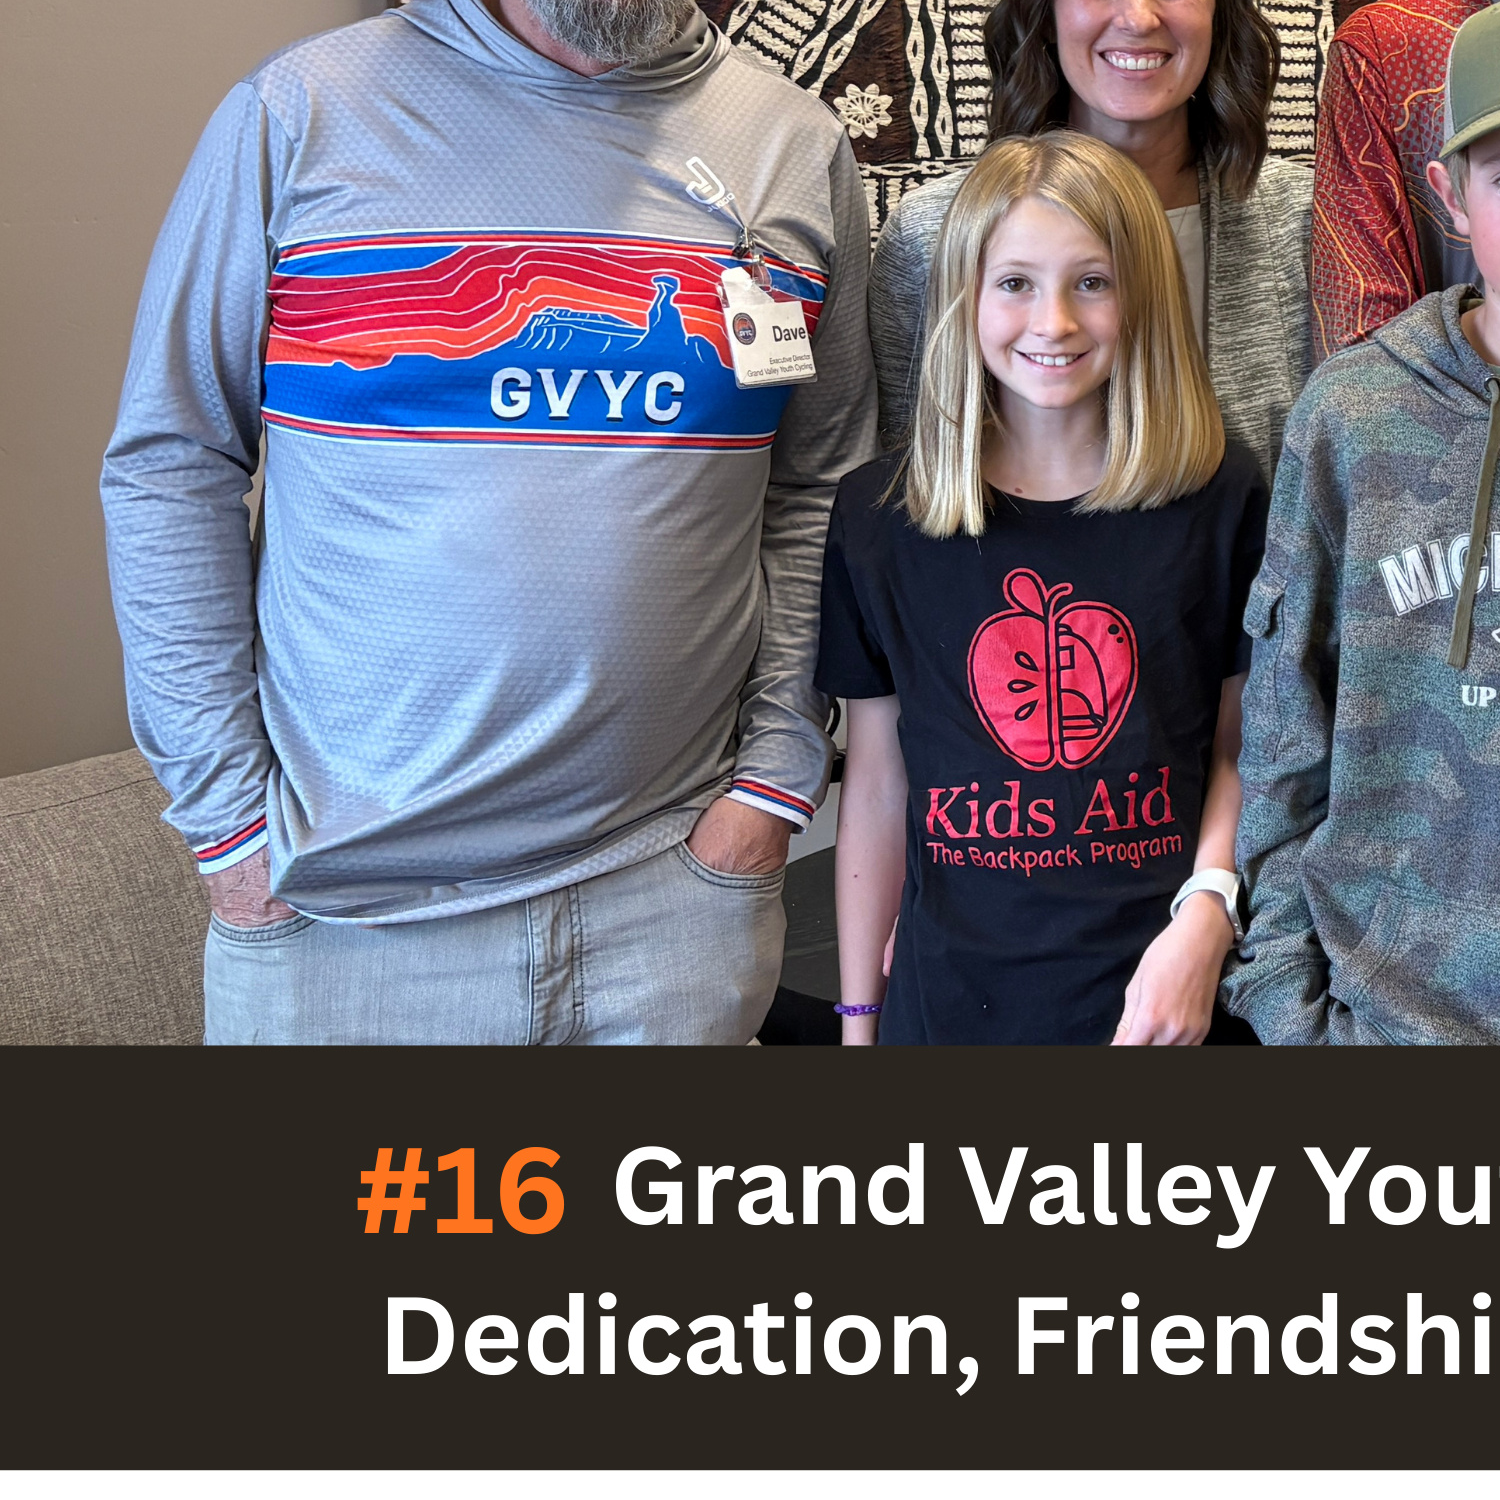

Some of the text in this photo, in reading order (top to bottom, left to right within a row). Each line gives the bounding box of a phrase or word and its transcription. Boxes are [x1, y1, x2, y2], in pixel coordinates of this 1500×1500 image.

[772, 325, 806, 342] Dave
[747, 362, 813, 377] Grand Valley Youth Cycling
[769, 356, 792, 365] Executive
[490, 367, 685, 426] GVYC
[1461, 684, 1497, 709] UP
[925, 766, 1176, 839] Kids Aid
[926, 834, 1182, 877] The Backpack Program
